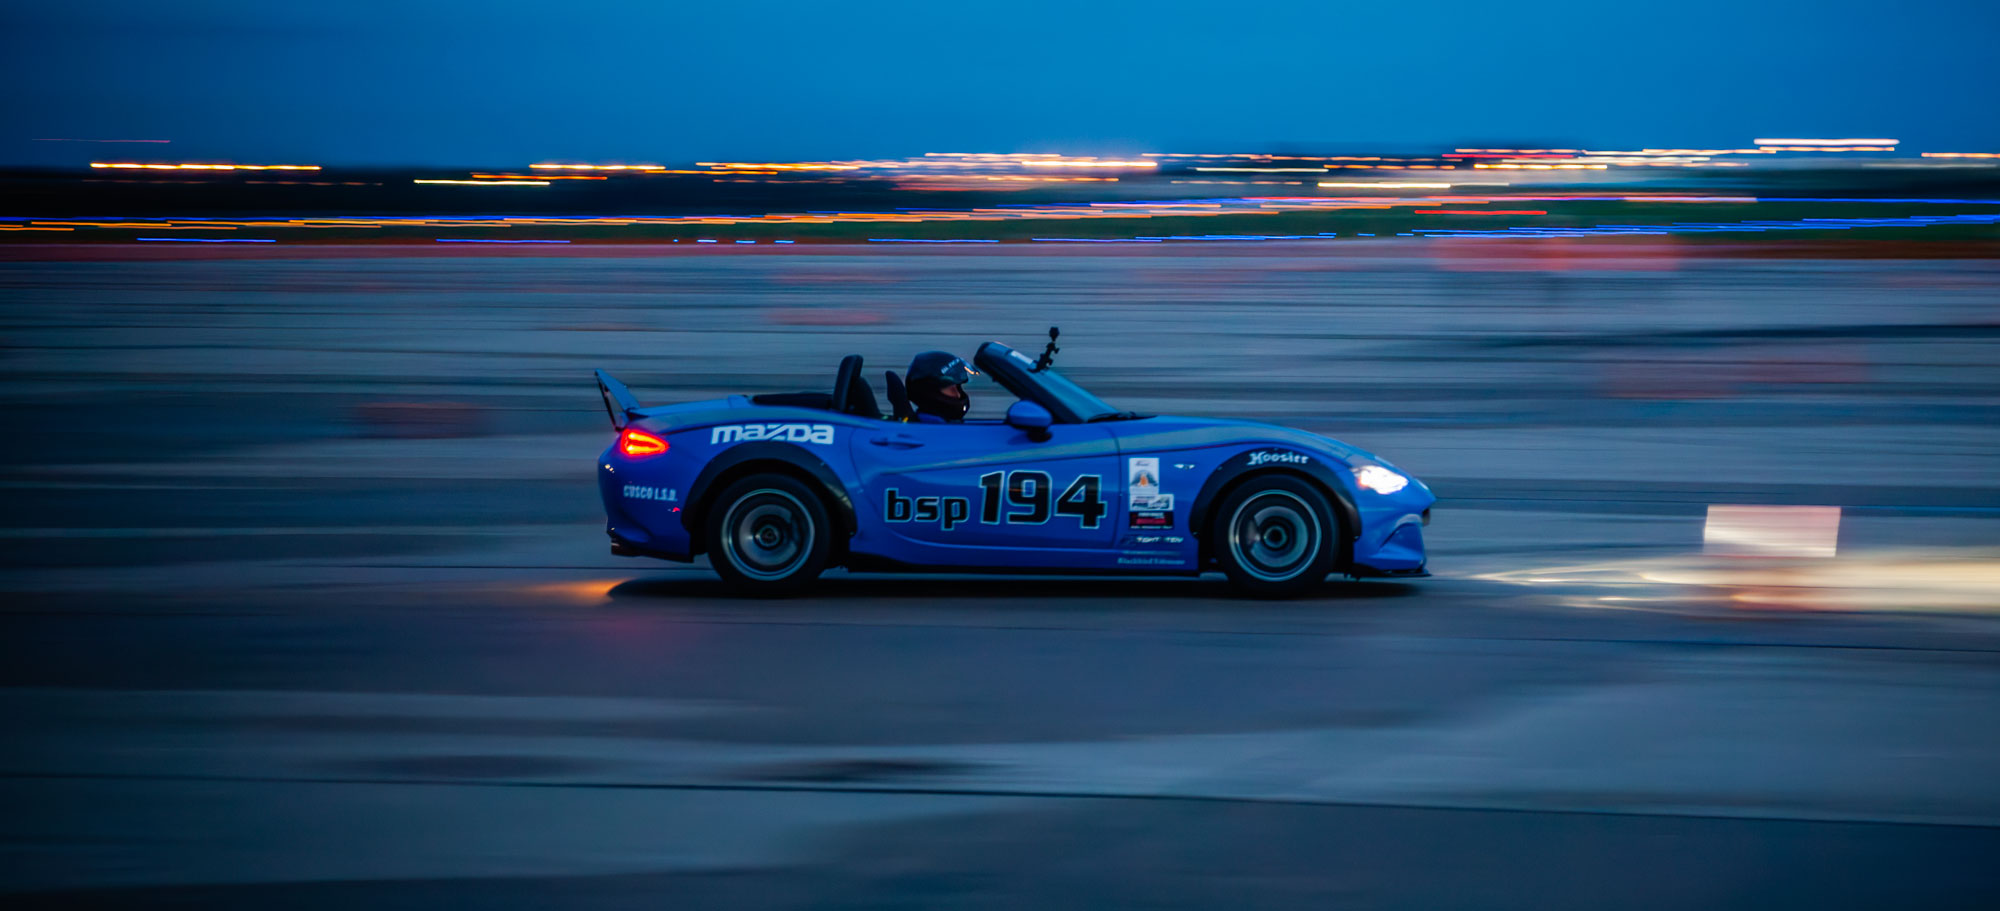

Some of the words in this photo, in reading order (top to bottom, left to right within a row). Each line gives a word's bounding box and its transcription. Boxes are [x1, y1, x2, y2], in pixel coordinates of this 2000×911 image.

[1247, 451, 1309, 465] Hoosier
[885, 487, 970, 531] bsp
[979, 470, 1108, 529] 194
